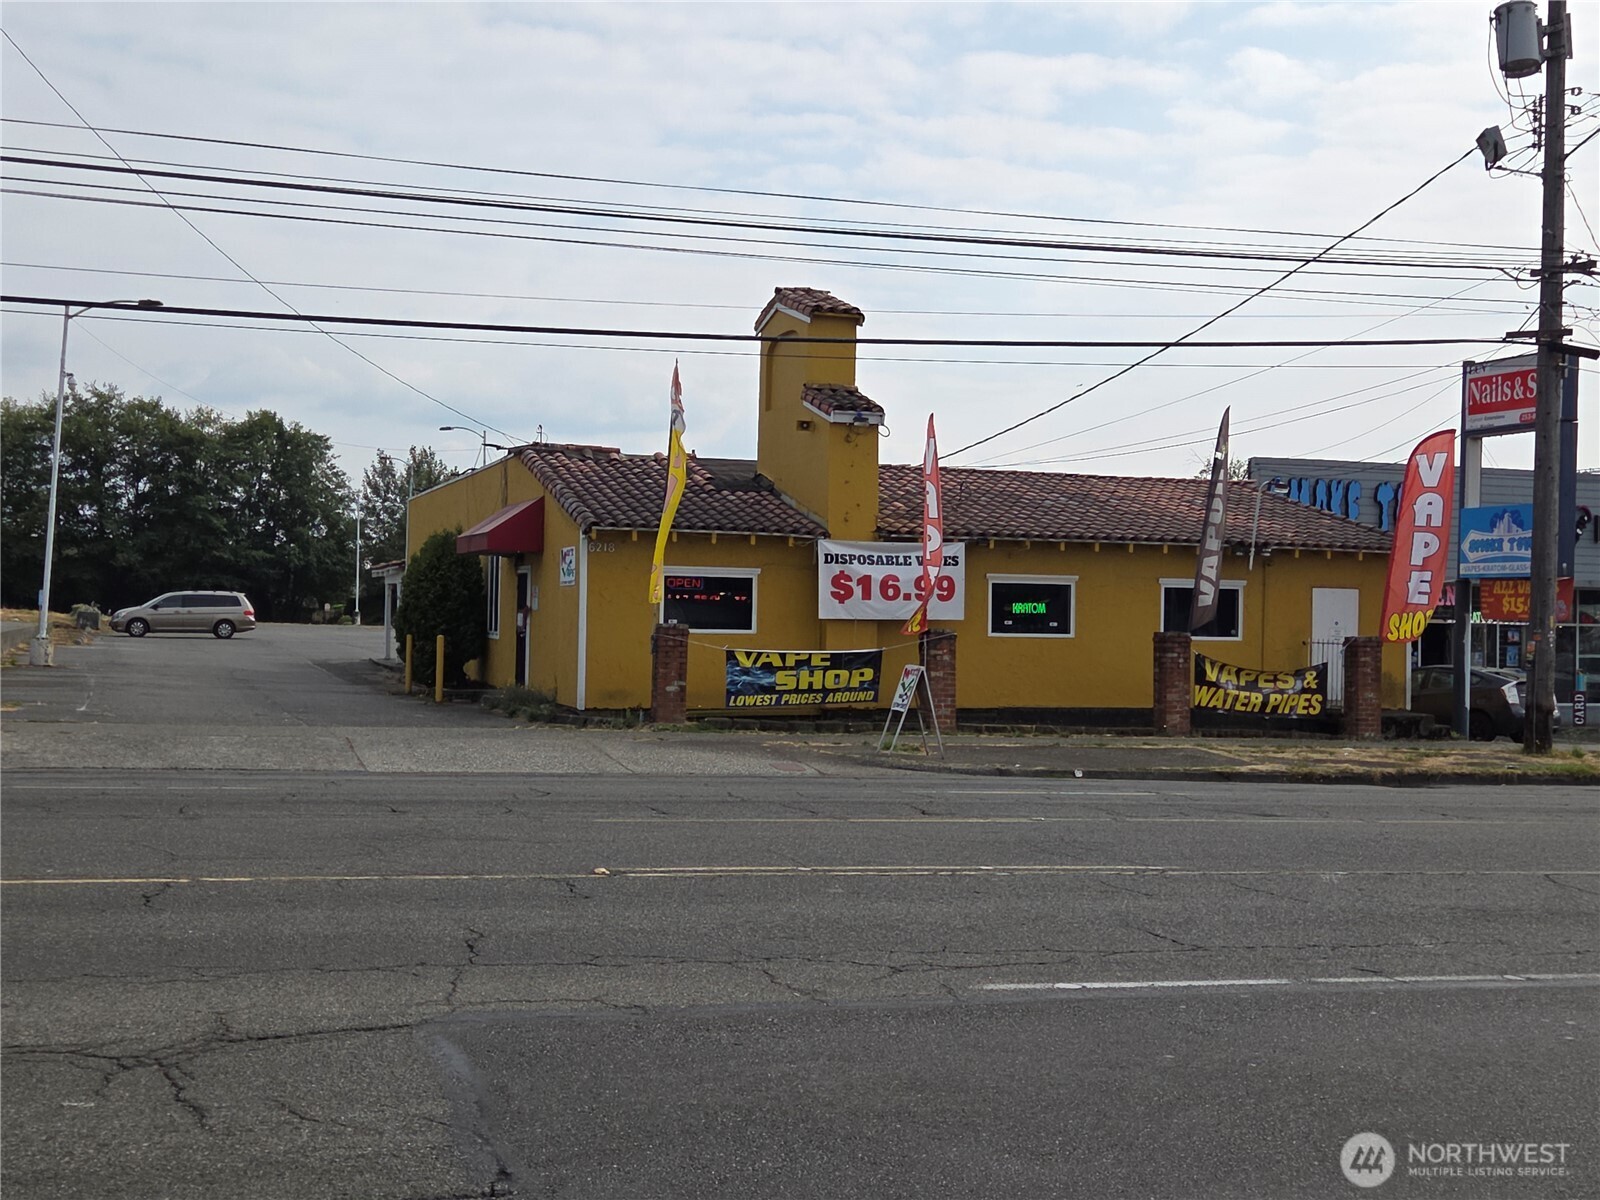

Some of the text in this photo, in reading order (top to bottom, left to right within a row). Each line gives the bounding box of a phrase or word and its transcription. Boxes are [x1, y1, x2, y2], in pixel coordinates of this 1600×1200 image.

[1407, 452, 1448, 605] VAPE
[588, 542, 615, 553] 6218
[824, 553, 959, 566] DISPOSABLE VES
[667, 578, 701, 588] OPEN
[1493, 580, 1515, 594] ALL
[1012, 602, 1047, 614] KRATOM
[1502, 594, 1531, 616] $15.
[734, 651, 831, 668] VAPE
[775, 668, 874, 691] SHOP
[1204, 658, 1319, 689] VAPES &
[729, 690, 875, 707] LOWEST PRICES AROUND
[1194, 685, 1323, 715] WATER PIPES
[1574, 694, 1585, 725] CARD
